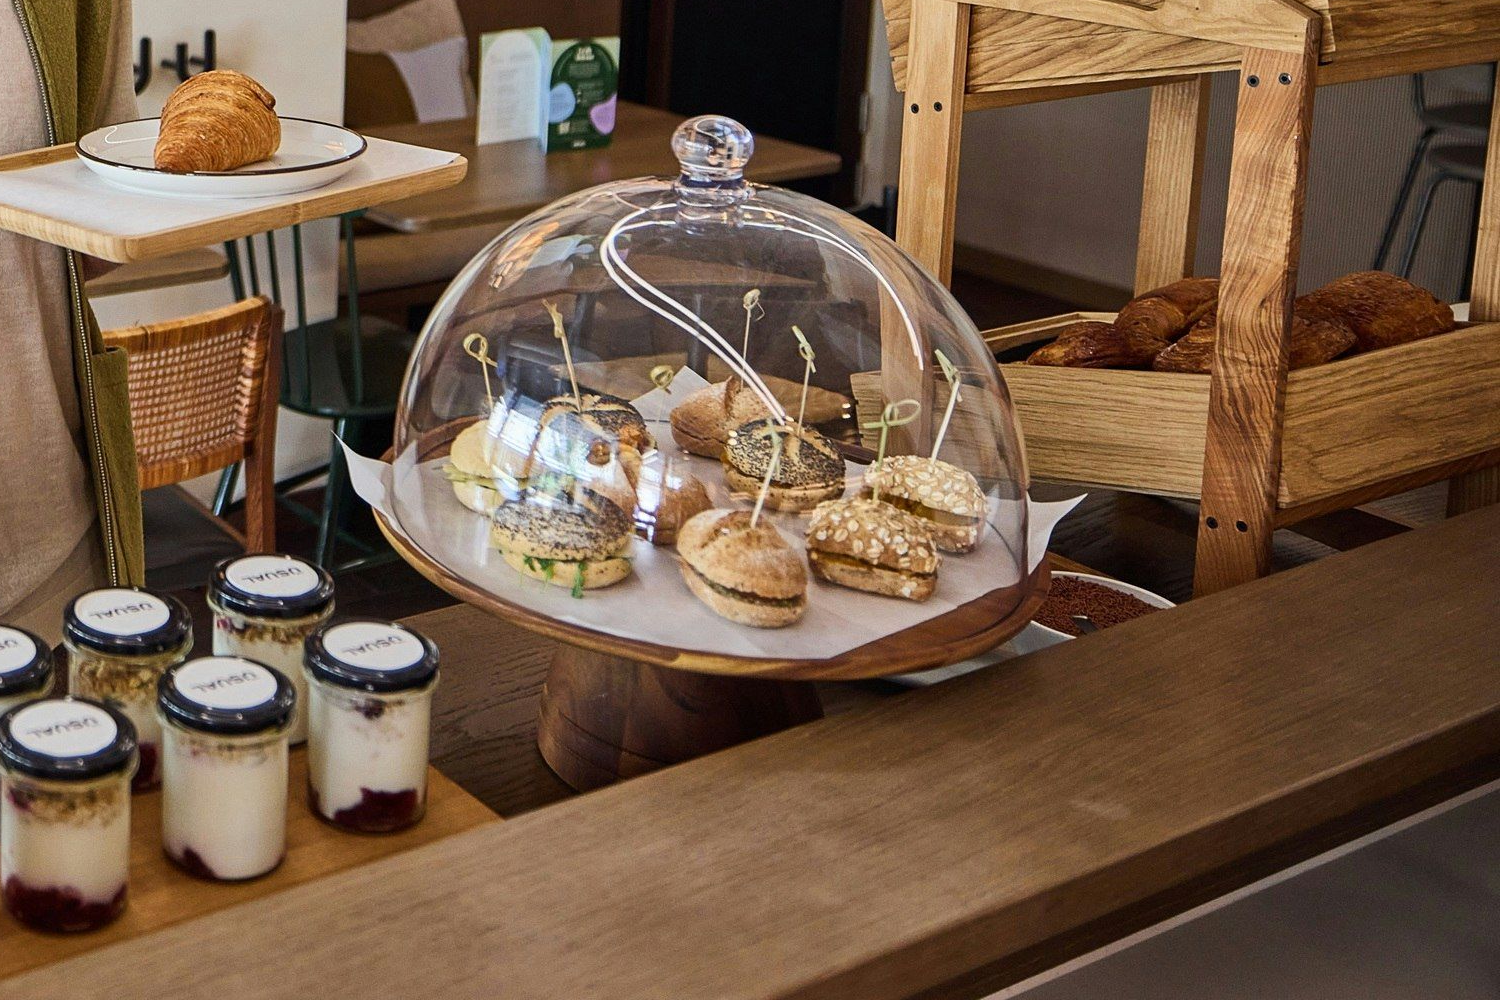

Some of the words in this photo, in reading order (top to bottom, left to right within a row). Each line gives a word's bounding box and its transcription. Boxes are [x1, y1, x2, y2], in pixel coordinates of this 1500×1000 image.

[242, 567, 302, 584] USUAL
[89, 603, 154, 620] USUAL
[342, 636, 404, 656] USUAL
[191, 673, 258, 693] USUAL
[26, 717, 100, 738] USUAL
